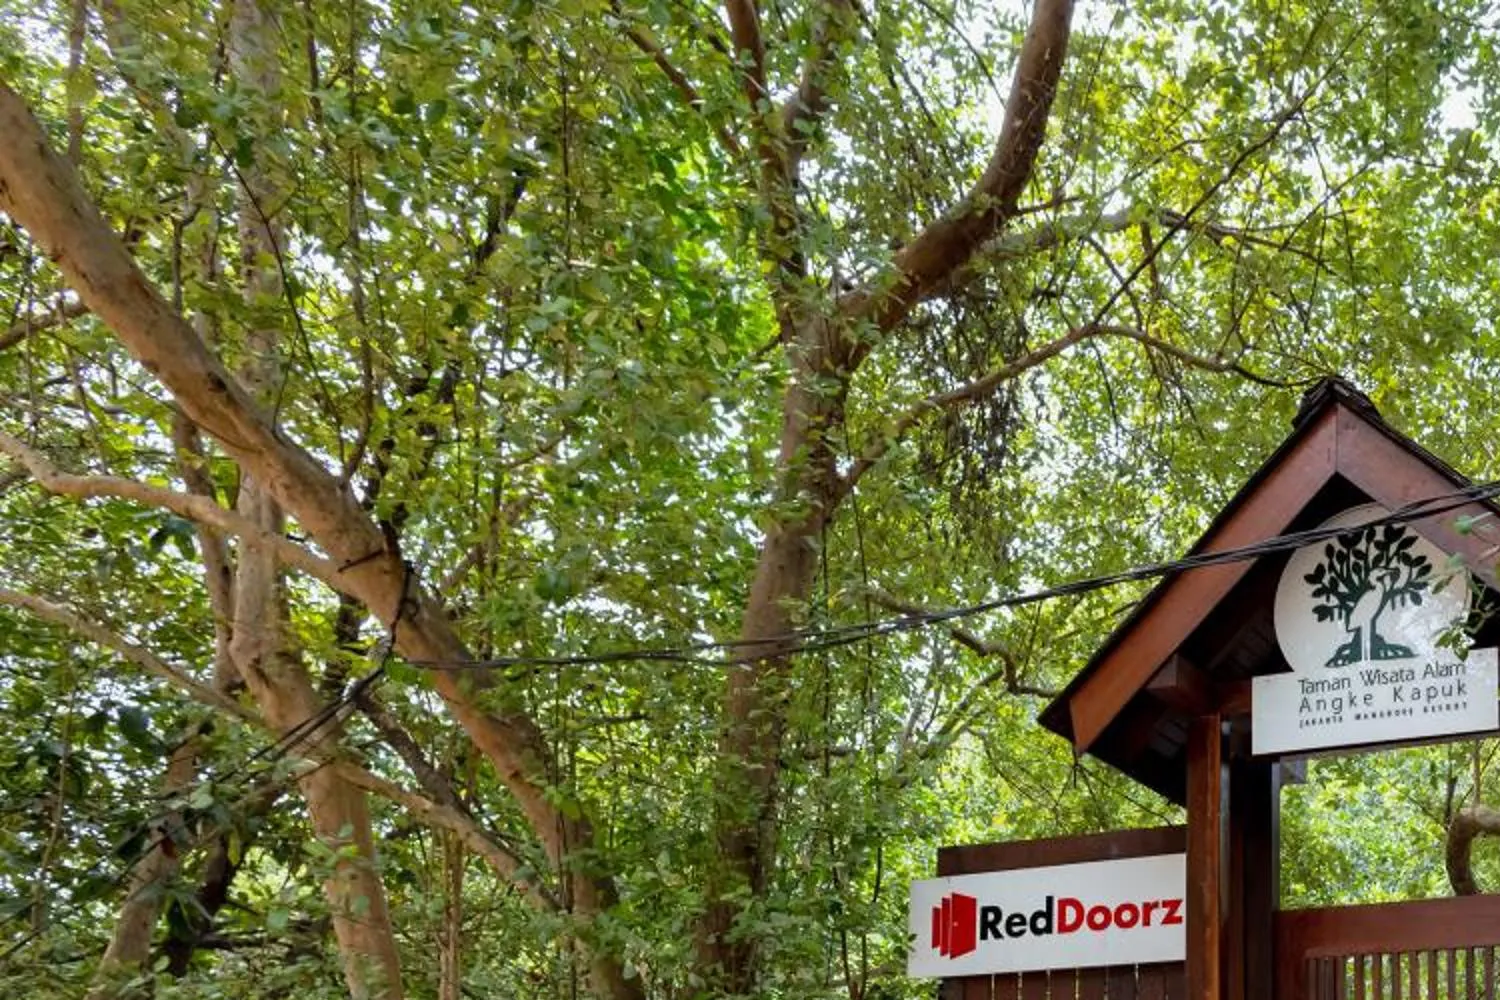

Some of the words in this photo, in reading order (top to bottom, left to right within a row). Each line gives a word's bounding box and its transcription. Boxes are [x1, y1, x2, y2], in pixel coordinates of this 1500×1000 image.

[1298, 678, 1351, 695] Taman
[1360, 668, 1415, 687] Wisata
[1423, 662, 1466, 679] Alam
[1299, 691, 1373, 715] Angke
[1393, 680, 1468, 703] Kapuk
[979, 895, 1184, 941] RedDoorz
